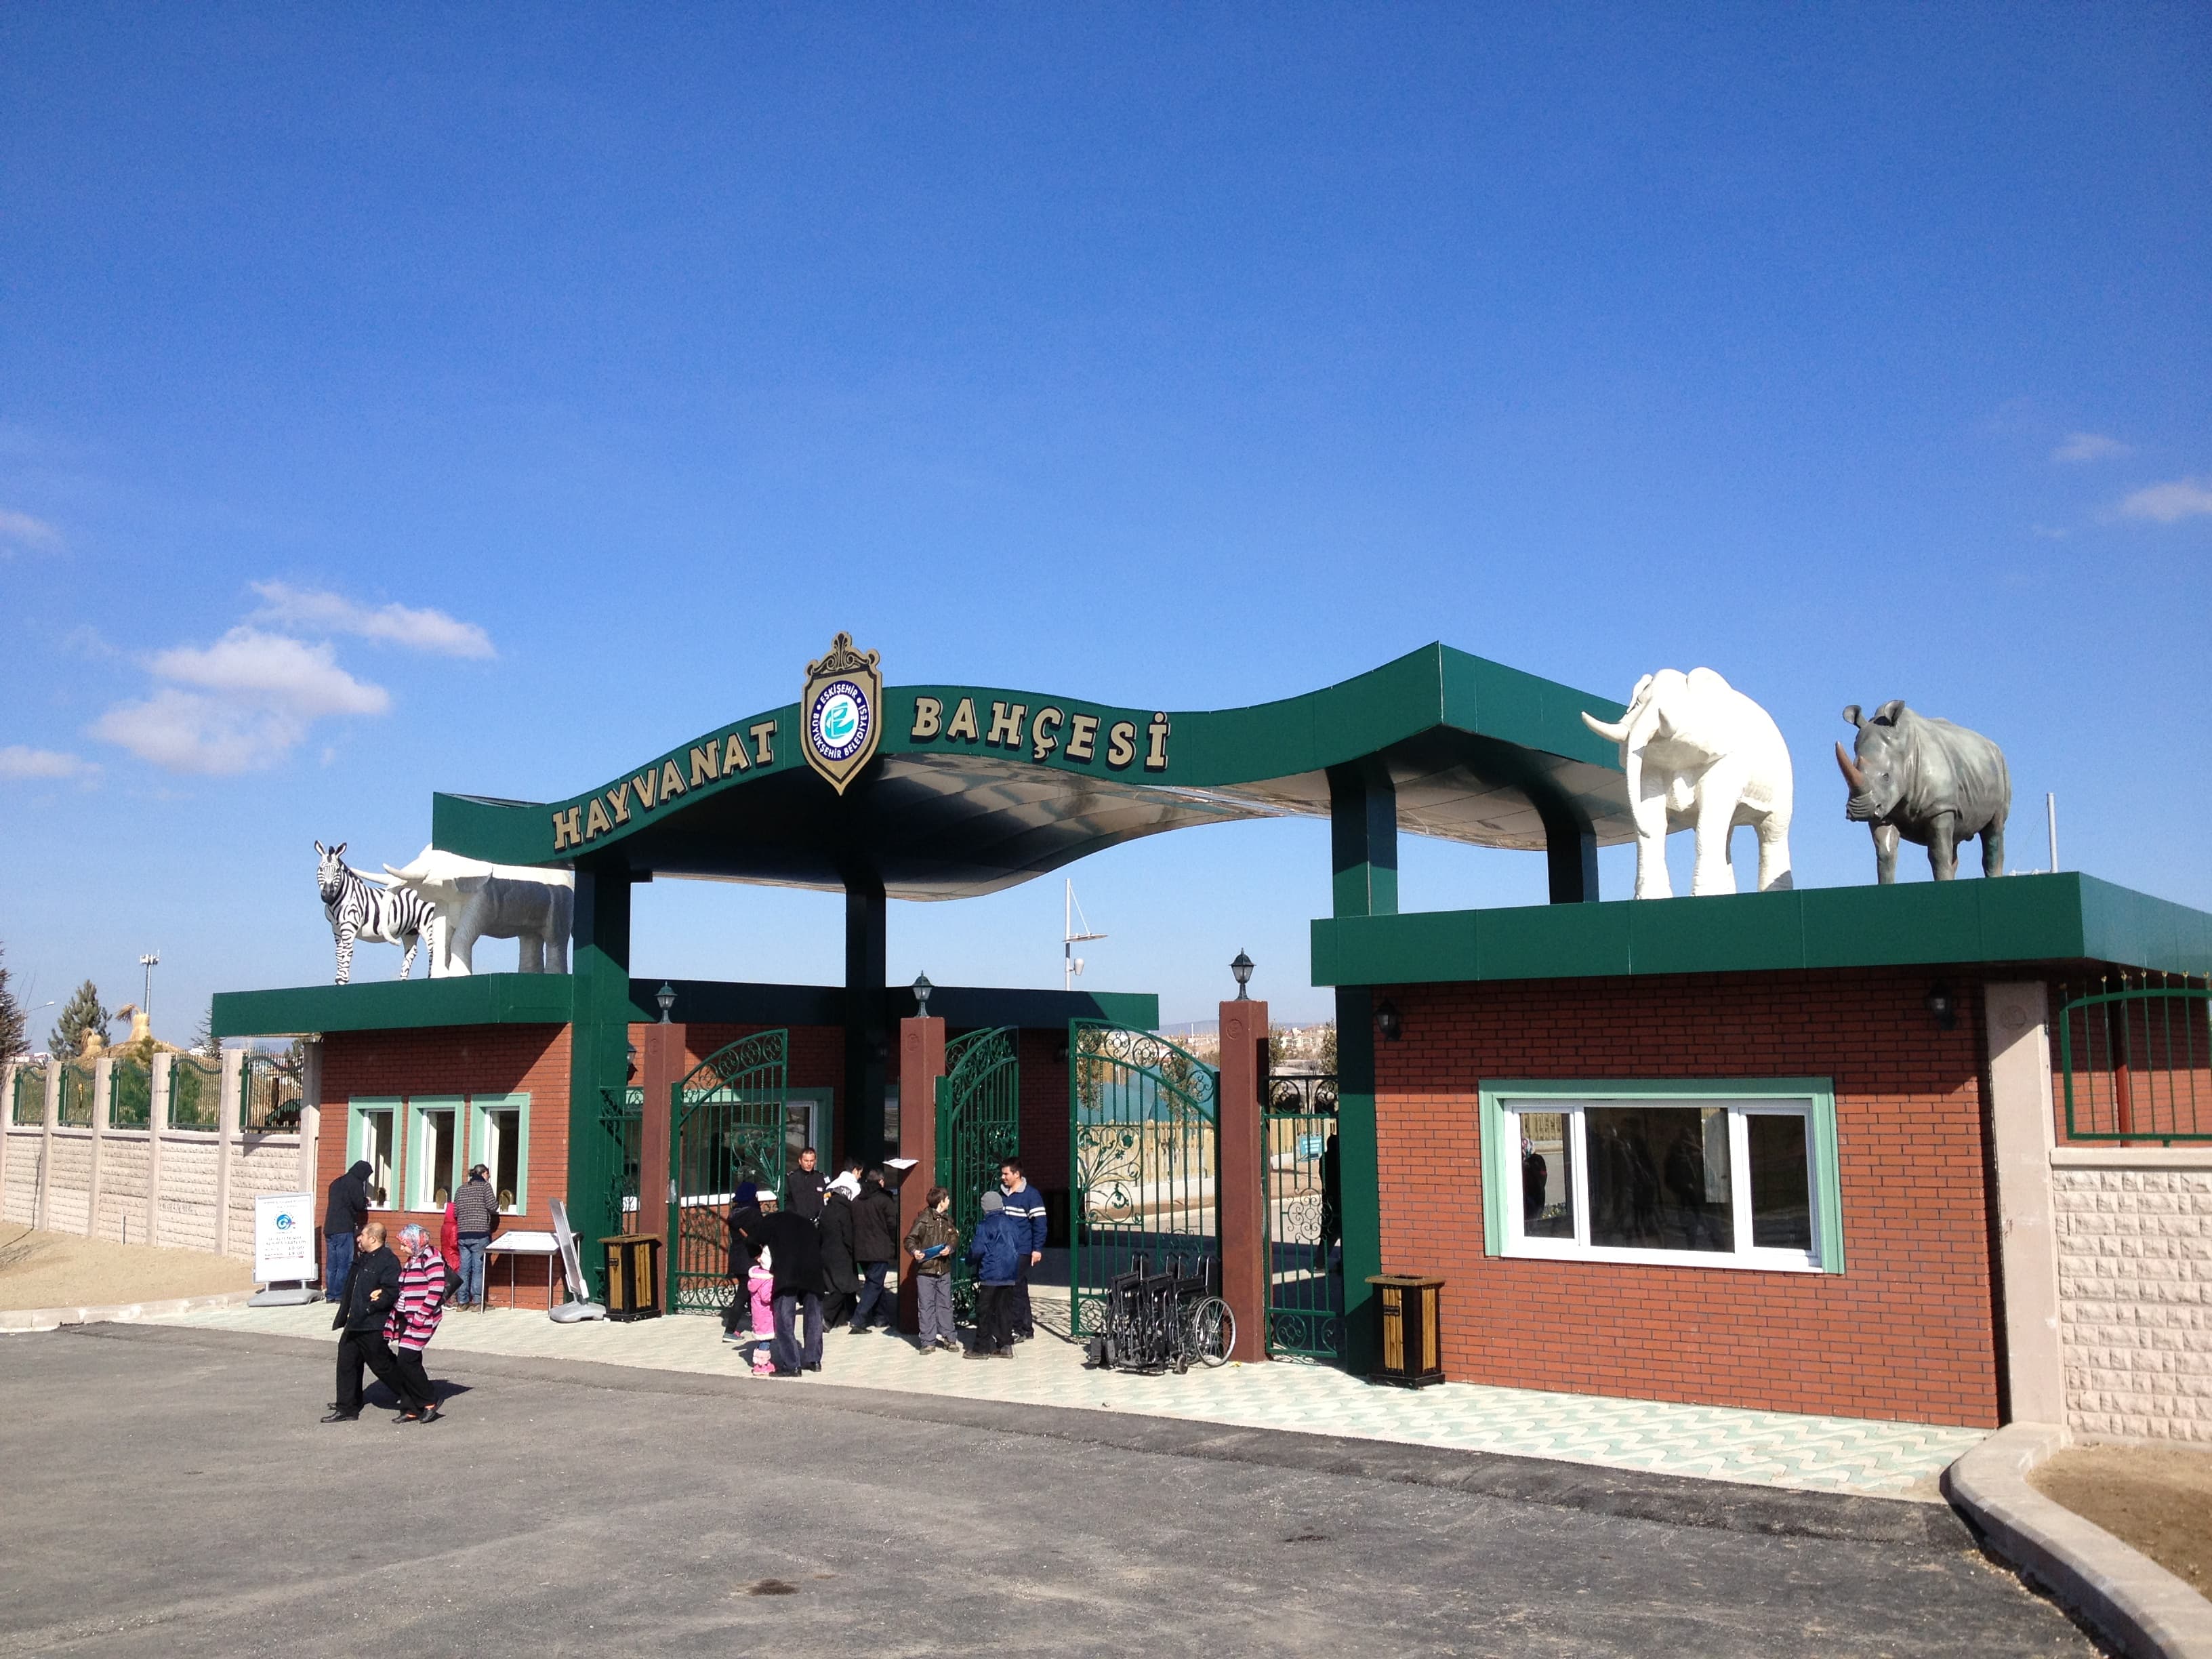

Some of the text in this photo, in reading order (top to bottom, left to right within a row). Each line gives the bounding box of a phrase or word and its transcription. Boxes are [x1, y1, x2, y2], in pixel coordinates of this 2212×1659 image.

[819, 683, 858, 703] ESKİŞEHİR
[812, 712, 842, 759] BÜYÜKŞEHİR
[552, 697, 1171, 851] HAYVANAT BAHÇESİ
